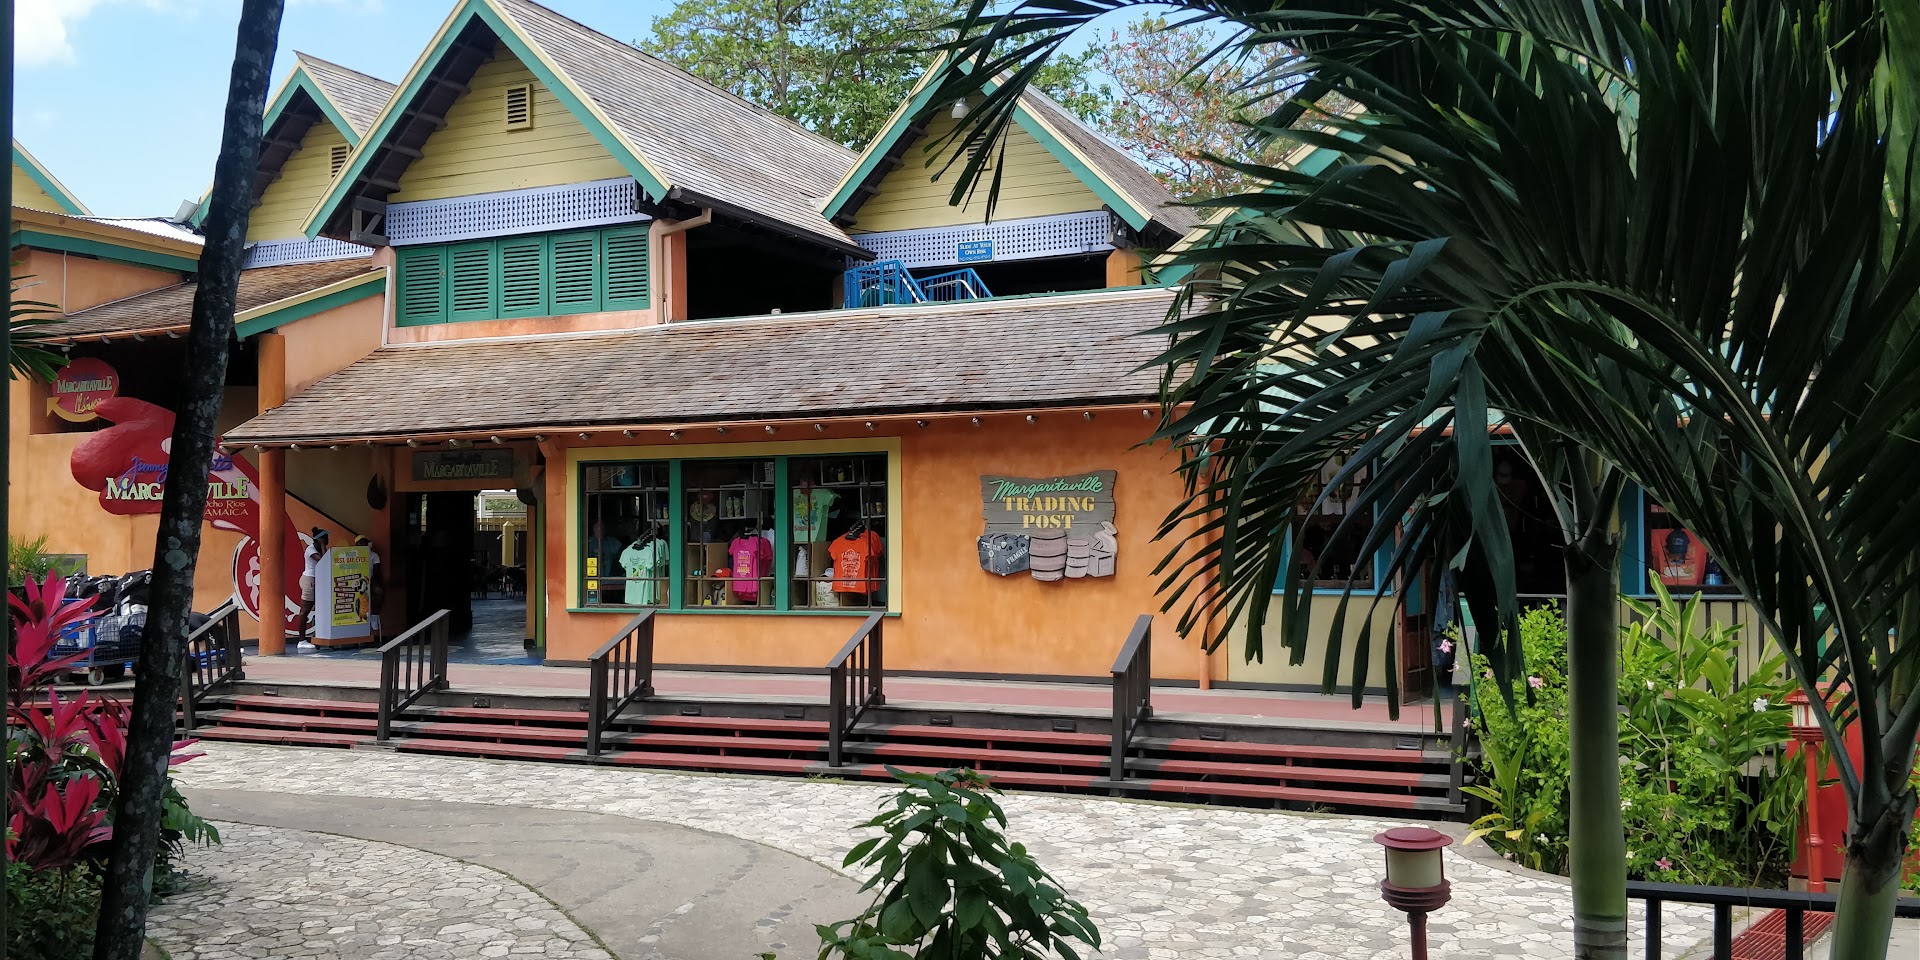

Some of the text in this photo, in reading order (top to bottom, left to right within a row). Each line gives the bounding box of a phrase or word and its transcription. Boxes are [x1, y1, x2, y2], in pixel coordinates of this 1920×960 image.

[989, 477, 1103, 502] Margaritaville
[227, 500, 246, 509] Rios
[1003, 496, 1095, 512] TRADING
[203, 509, 249, 517] AMAICA
[1022, 514, 1075, 529] POST
